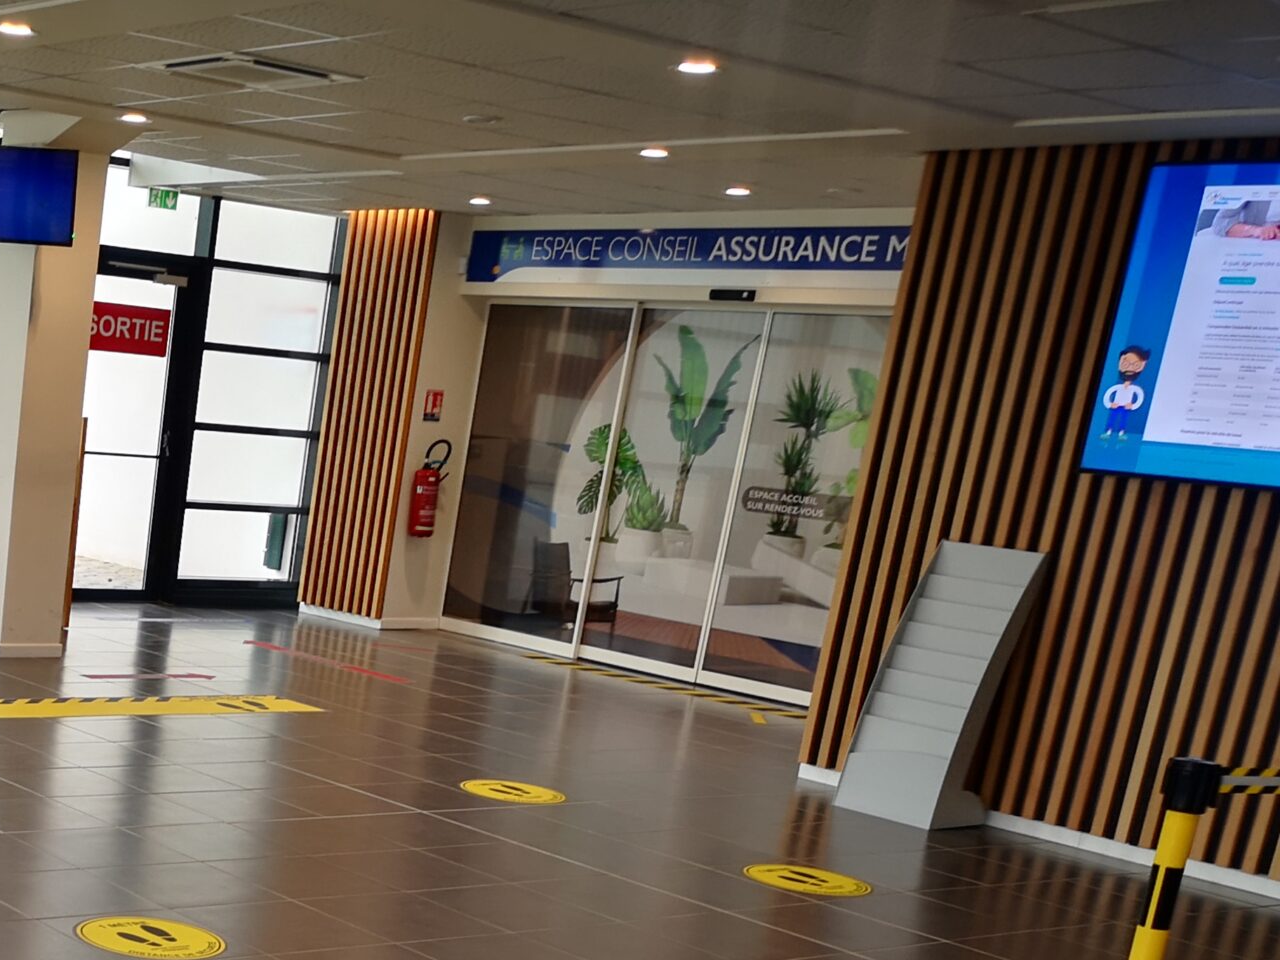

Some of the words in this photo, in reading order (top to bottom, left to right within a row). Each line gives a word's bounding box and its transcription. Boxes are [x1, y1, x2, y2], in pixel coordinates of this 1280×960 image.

[531, 236, 603, 262] ESPACE
[608, 236, 702, 262] CONSEIL
[708, 235, 880, 263] ASSURANCE
[748, 489, 780, 501] ESPACE
[780, 494, 818, 505] ACCUEIL
[746, 500, 764, 511] SUR
[764, 503, 824, 518] RENDEZ-VOUS
